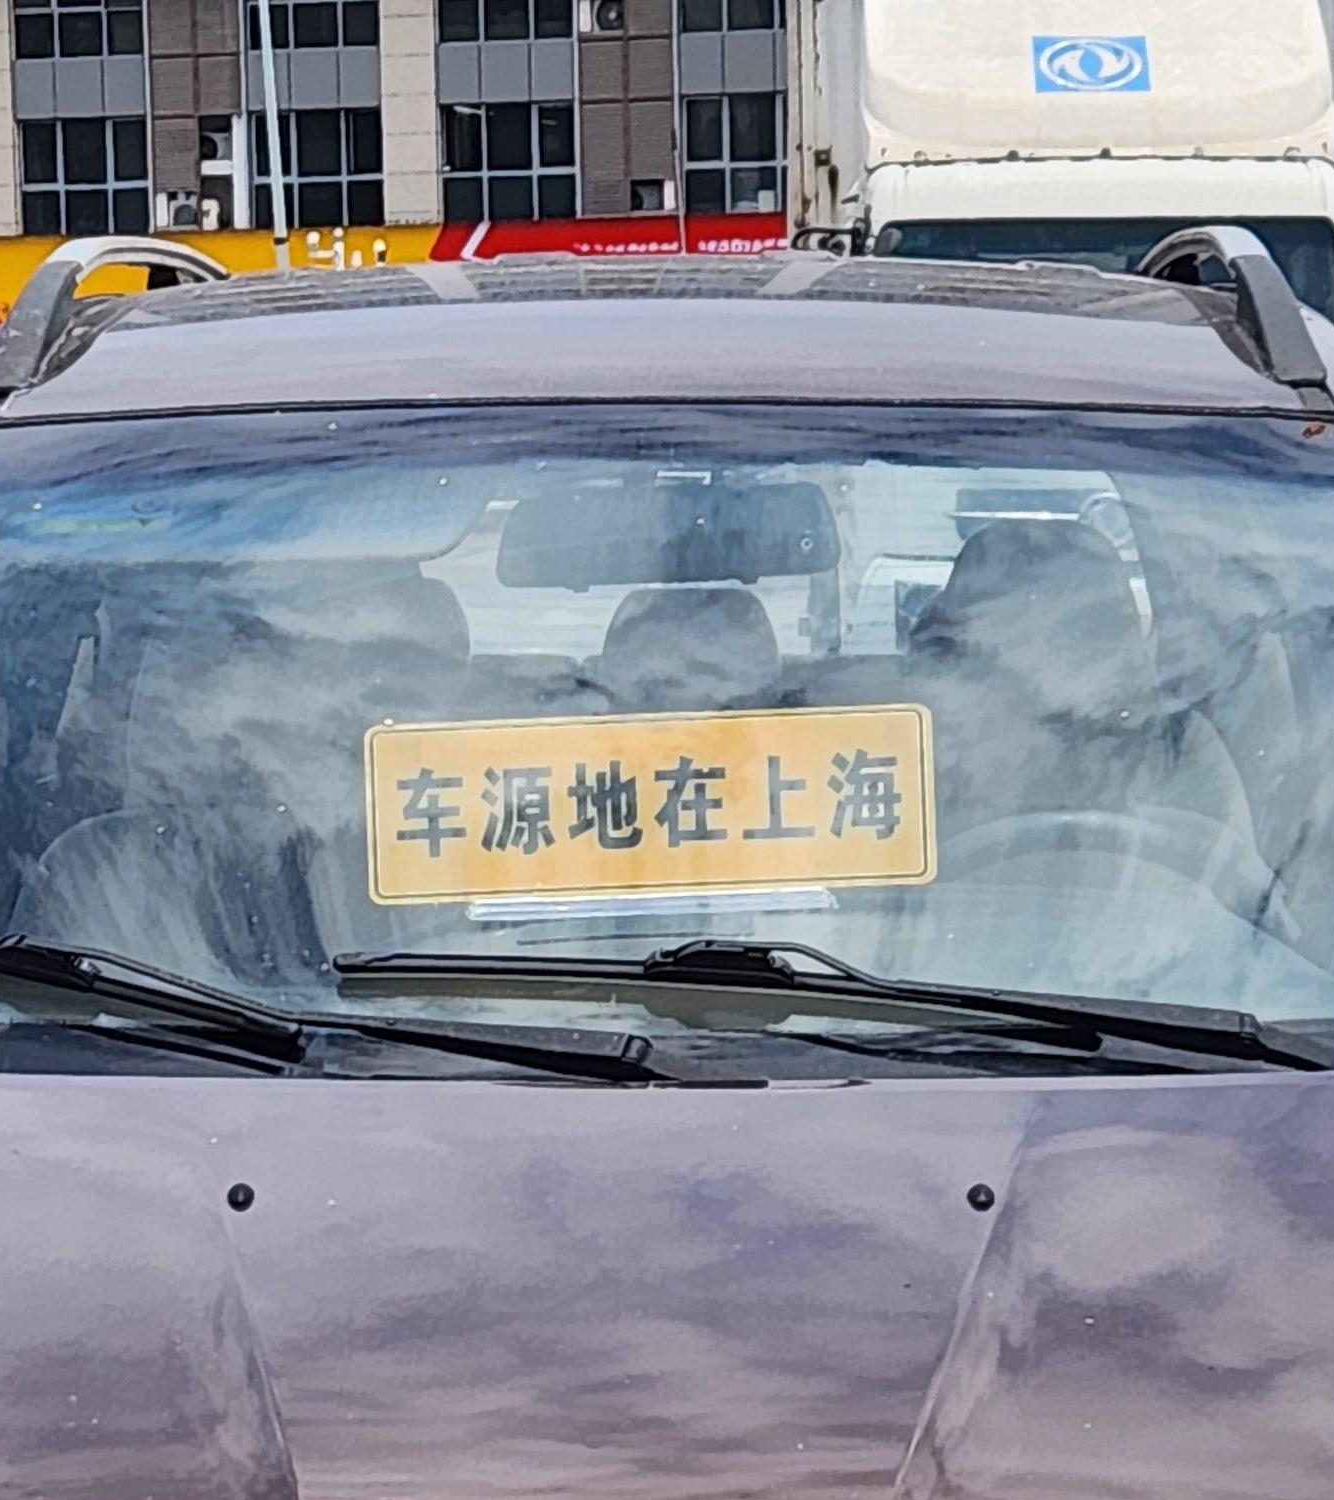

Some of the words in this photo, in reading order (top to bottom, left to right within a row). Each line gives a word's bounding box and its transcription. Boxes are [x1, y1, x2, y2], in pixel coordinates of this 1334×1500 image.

[396, 748, 903, 857] 车源地在上海
